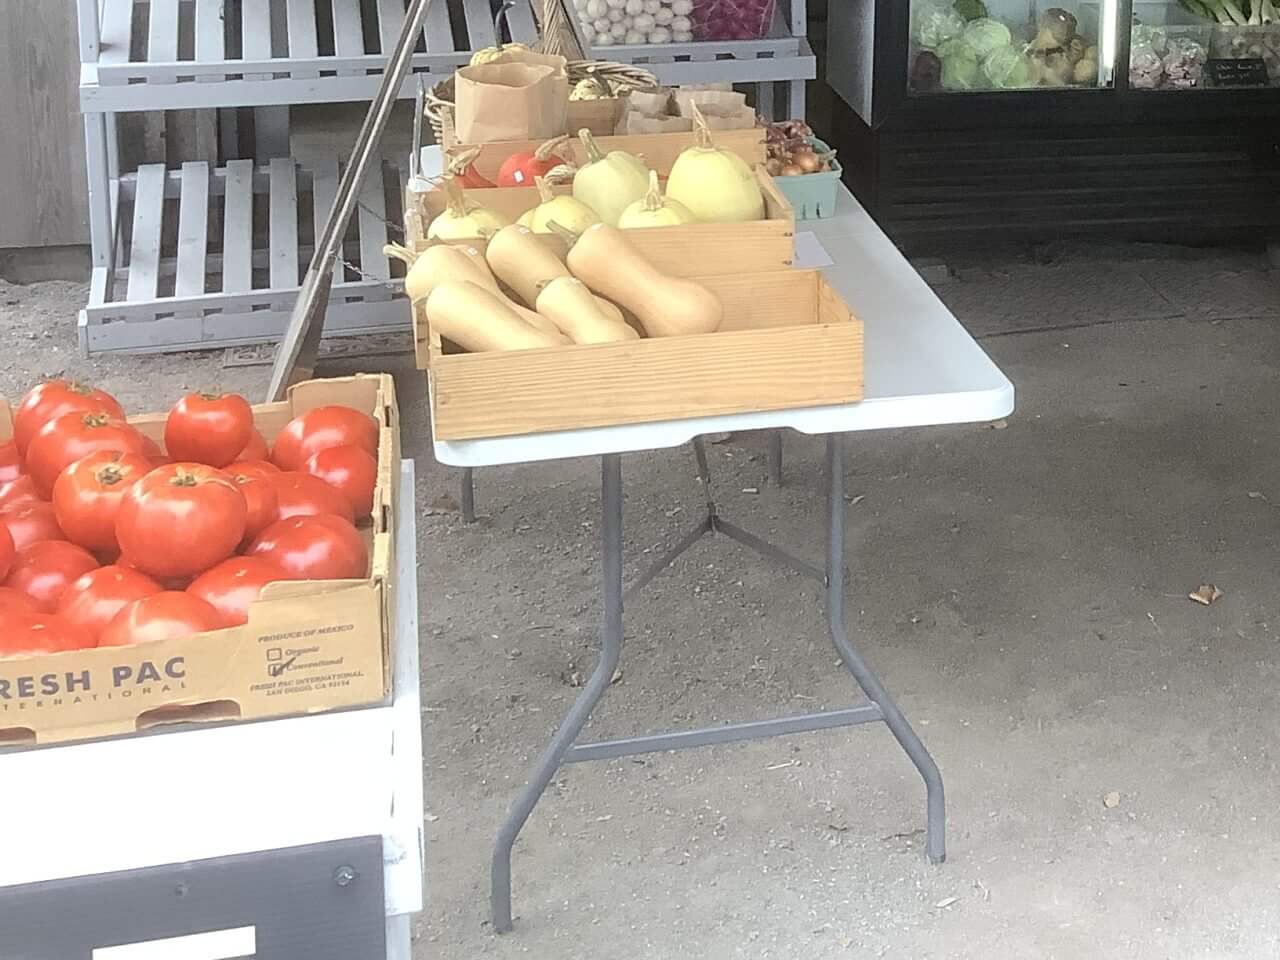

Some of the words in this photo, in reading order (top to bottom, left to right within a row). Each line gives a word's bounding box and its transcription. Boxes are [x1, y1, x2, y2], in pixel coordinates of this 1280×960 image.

[258, 631, 300, 642] PRODUCE
[304, 629, 316, 637] OF
[317, 624, 354, 635] MEXICO
[285, 645, 320, 656] Organic
[112, 656, 186, 688] PAC
[278, 679, 294, 687] PAC
